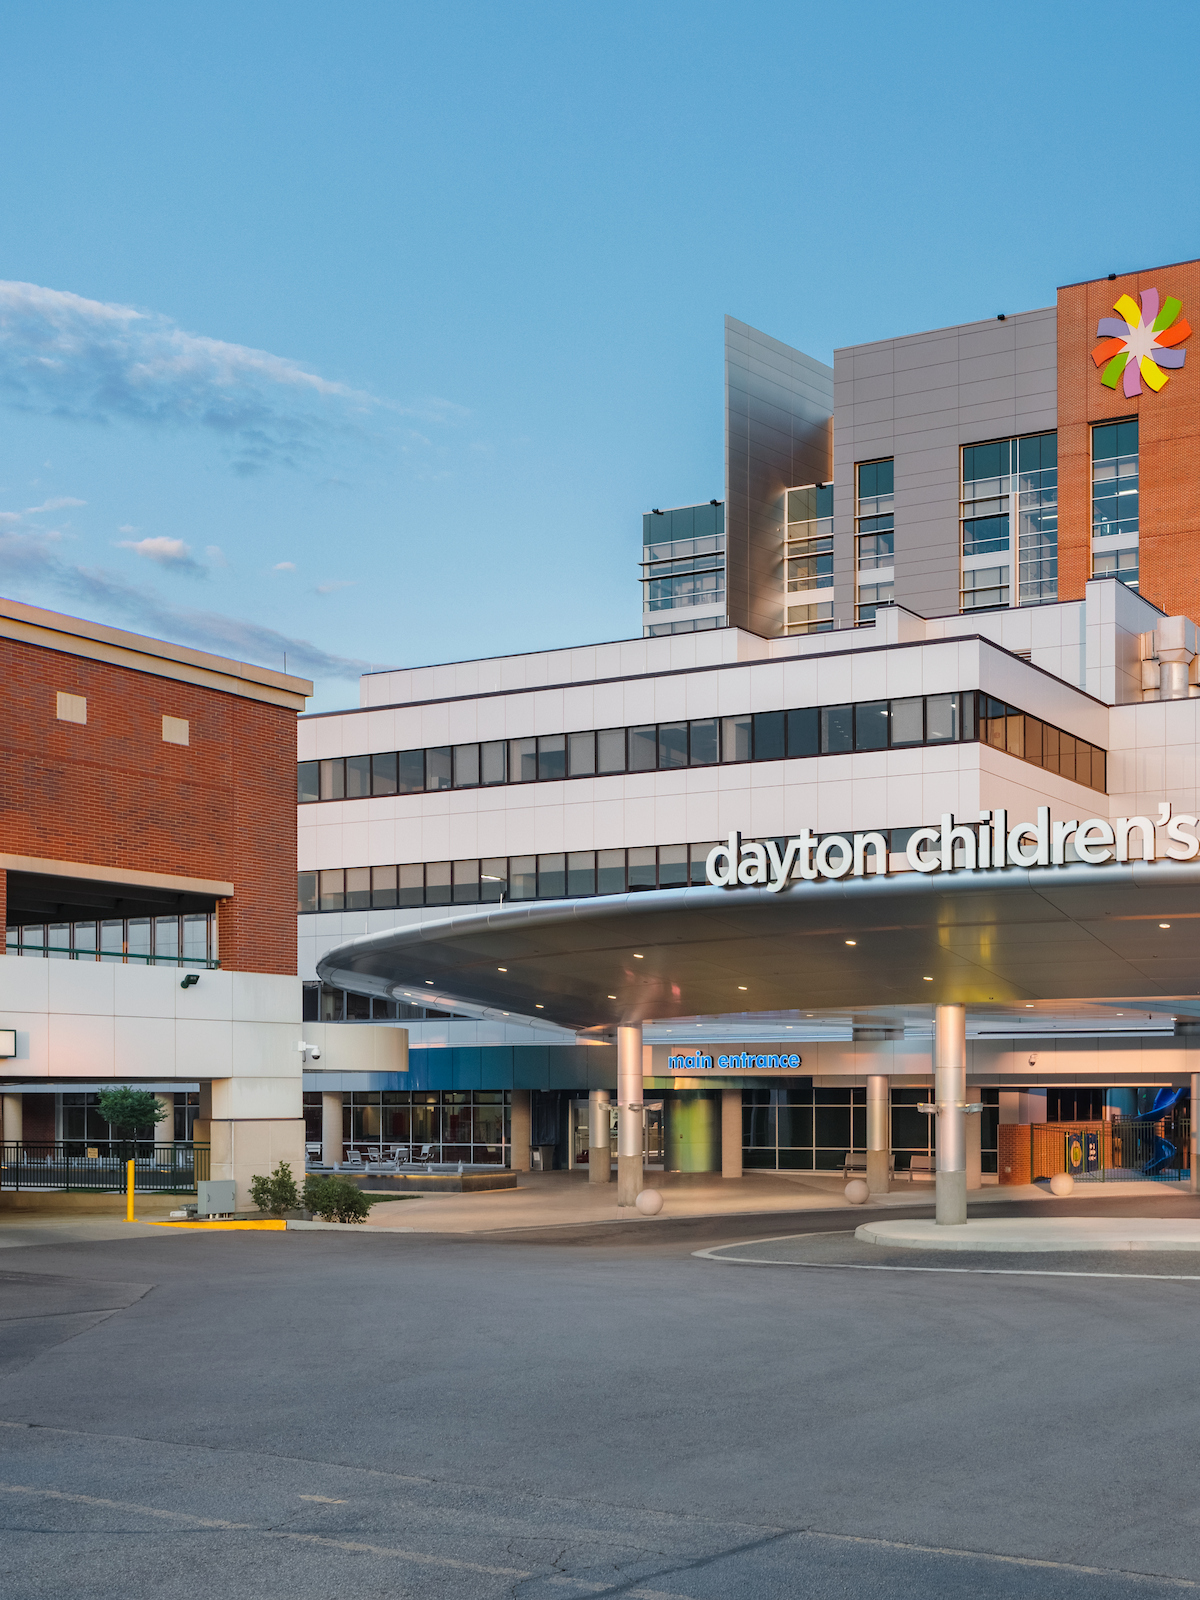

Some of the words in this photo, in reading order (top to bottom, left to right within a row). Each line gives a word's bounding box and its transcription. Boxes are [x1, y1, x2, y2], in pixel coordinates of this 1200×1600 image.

[705, 828, 889, 892] dayton
[668, 1050, 713, 1069] main
[717, 1051, 802, 1069] entrance
